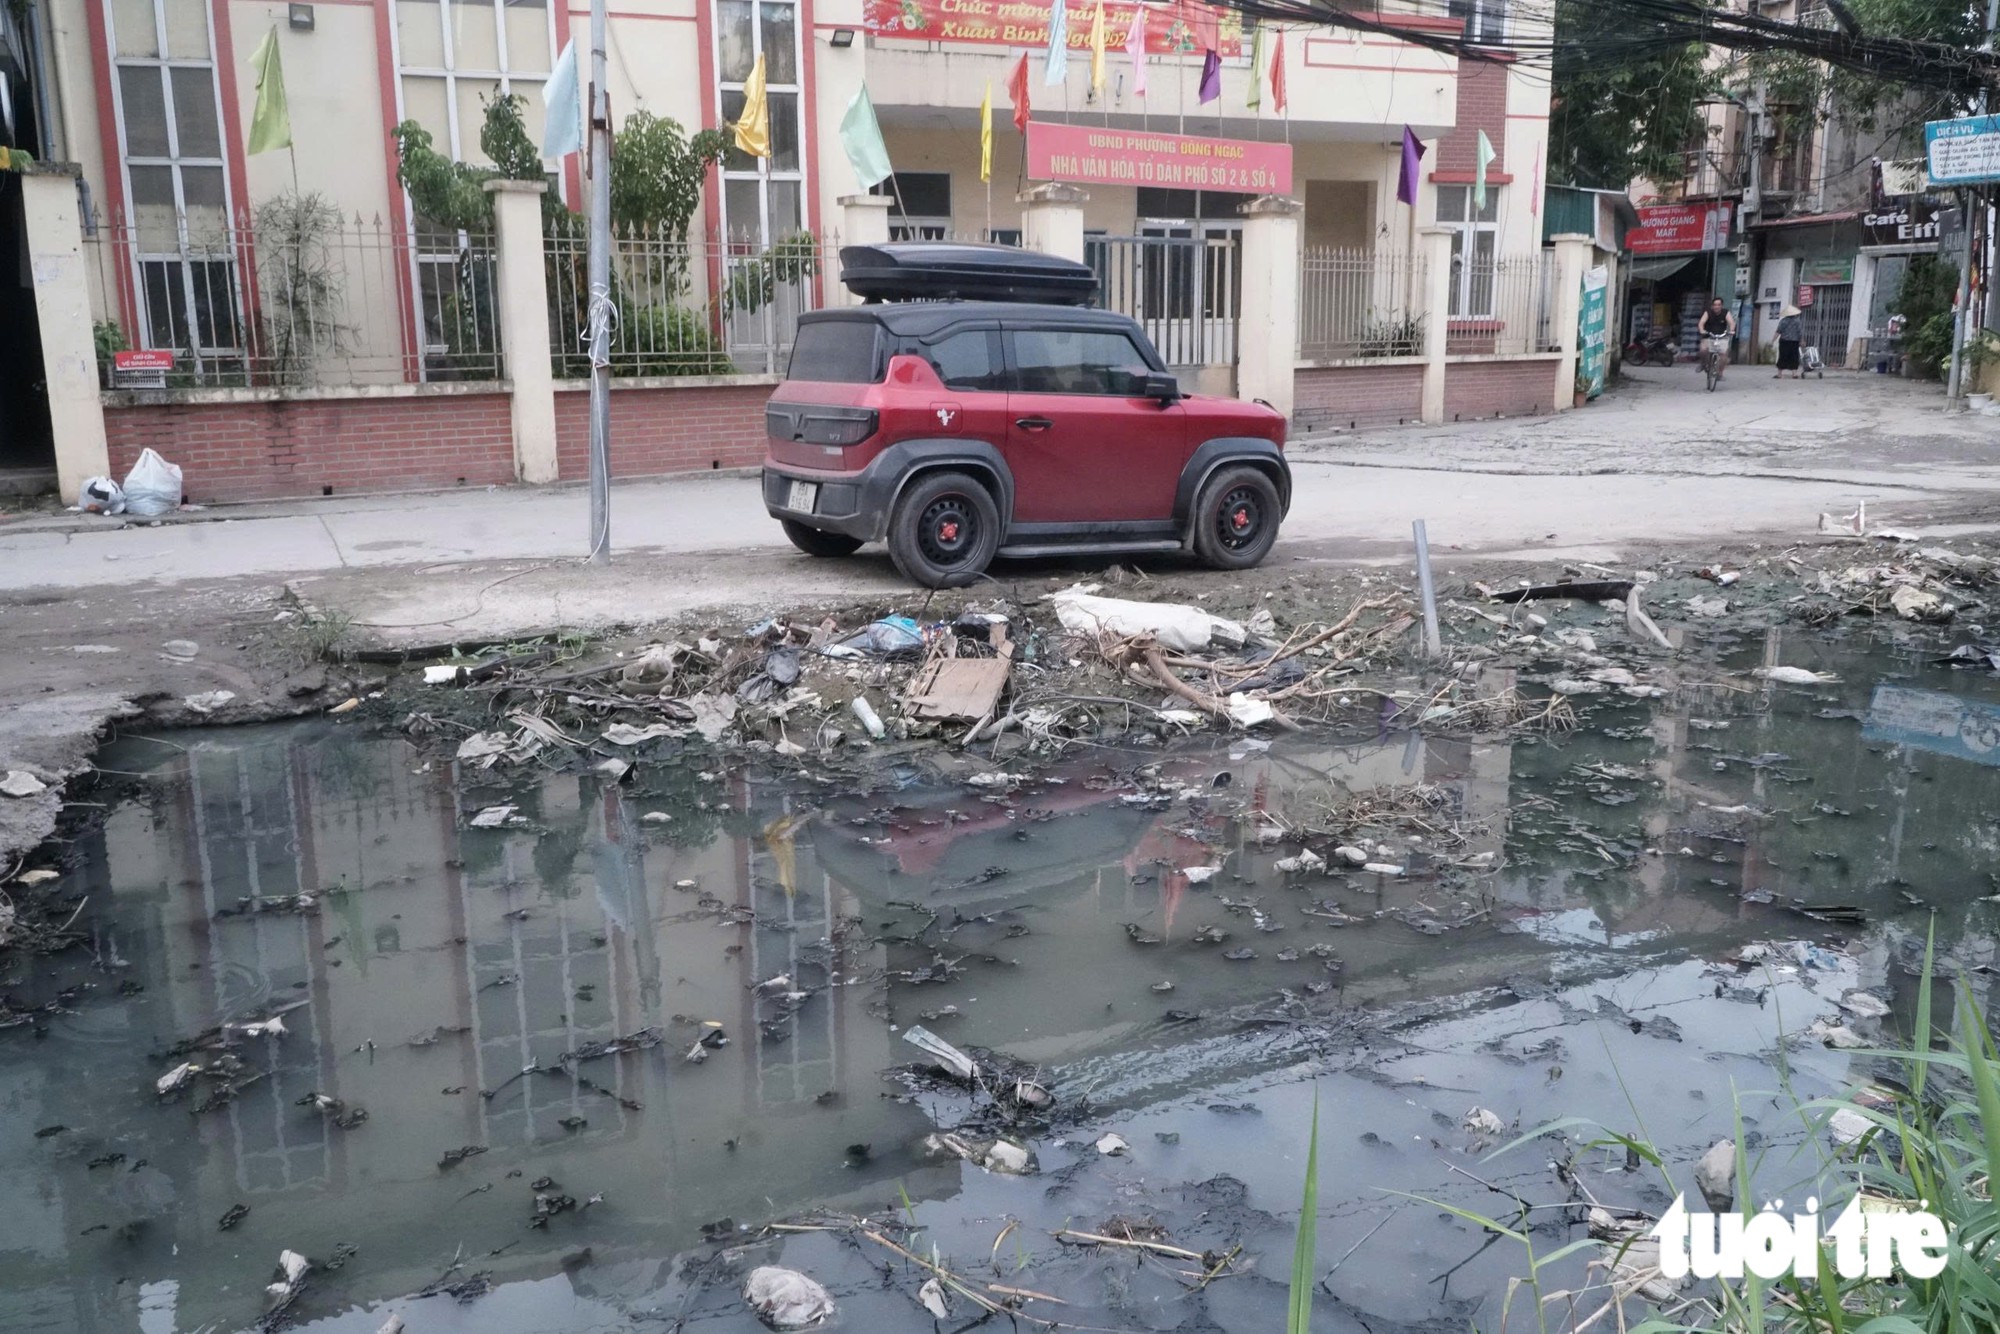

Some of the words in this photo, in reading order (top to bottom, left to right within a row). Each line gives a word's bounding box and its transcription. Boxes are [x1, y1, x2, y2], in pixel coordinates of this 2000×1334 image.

[1112, 9, 1150, 24] mi
[1088, 134, 1123, 149] UBND
[1127, 136, 1176, 153] PHƯỜNG
[1180, 140, 1211, 157] ĐÔNG
[1214, 144, 1244, 160] NGẠC
[1050, 151, 1078, 175] NHÀ
[1082, 152, 1107, 178] VĂN
[1138, 154, 1153, 180] TỔ
[1156, 160, 1181, 183] DÂN
[1185, 160, 1208, 184] PHỐ
[1211, 161, 1226, 185] SỐ
[1229, 168, 1236, 186] 2
[1240, 169, 1248, 186] &
[1251, 164, 1266, 188] SỐ
[1268, 171, 1276, 188] 4
[1670, 215, 1696, 226] GIANG
[1863, 208, 1909, 226] Café
[1655, 228, 1677, 238] MART
